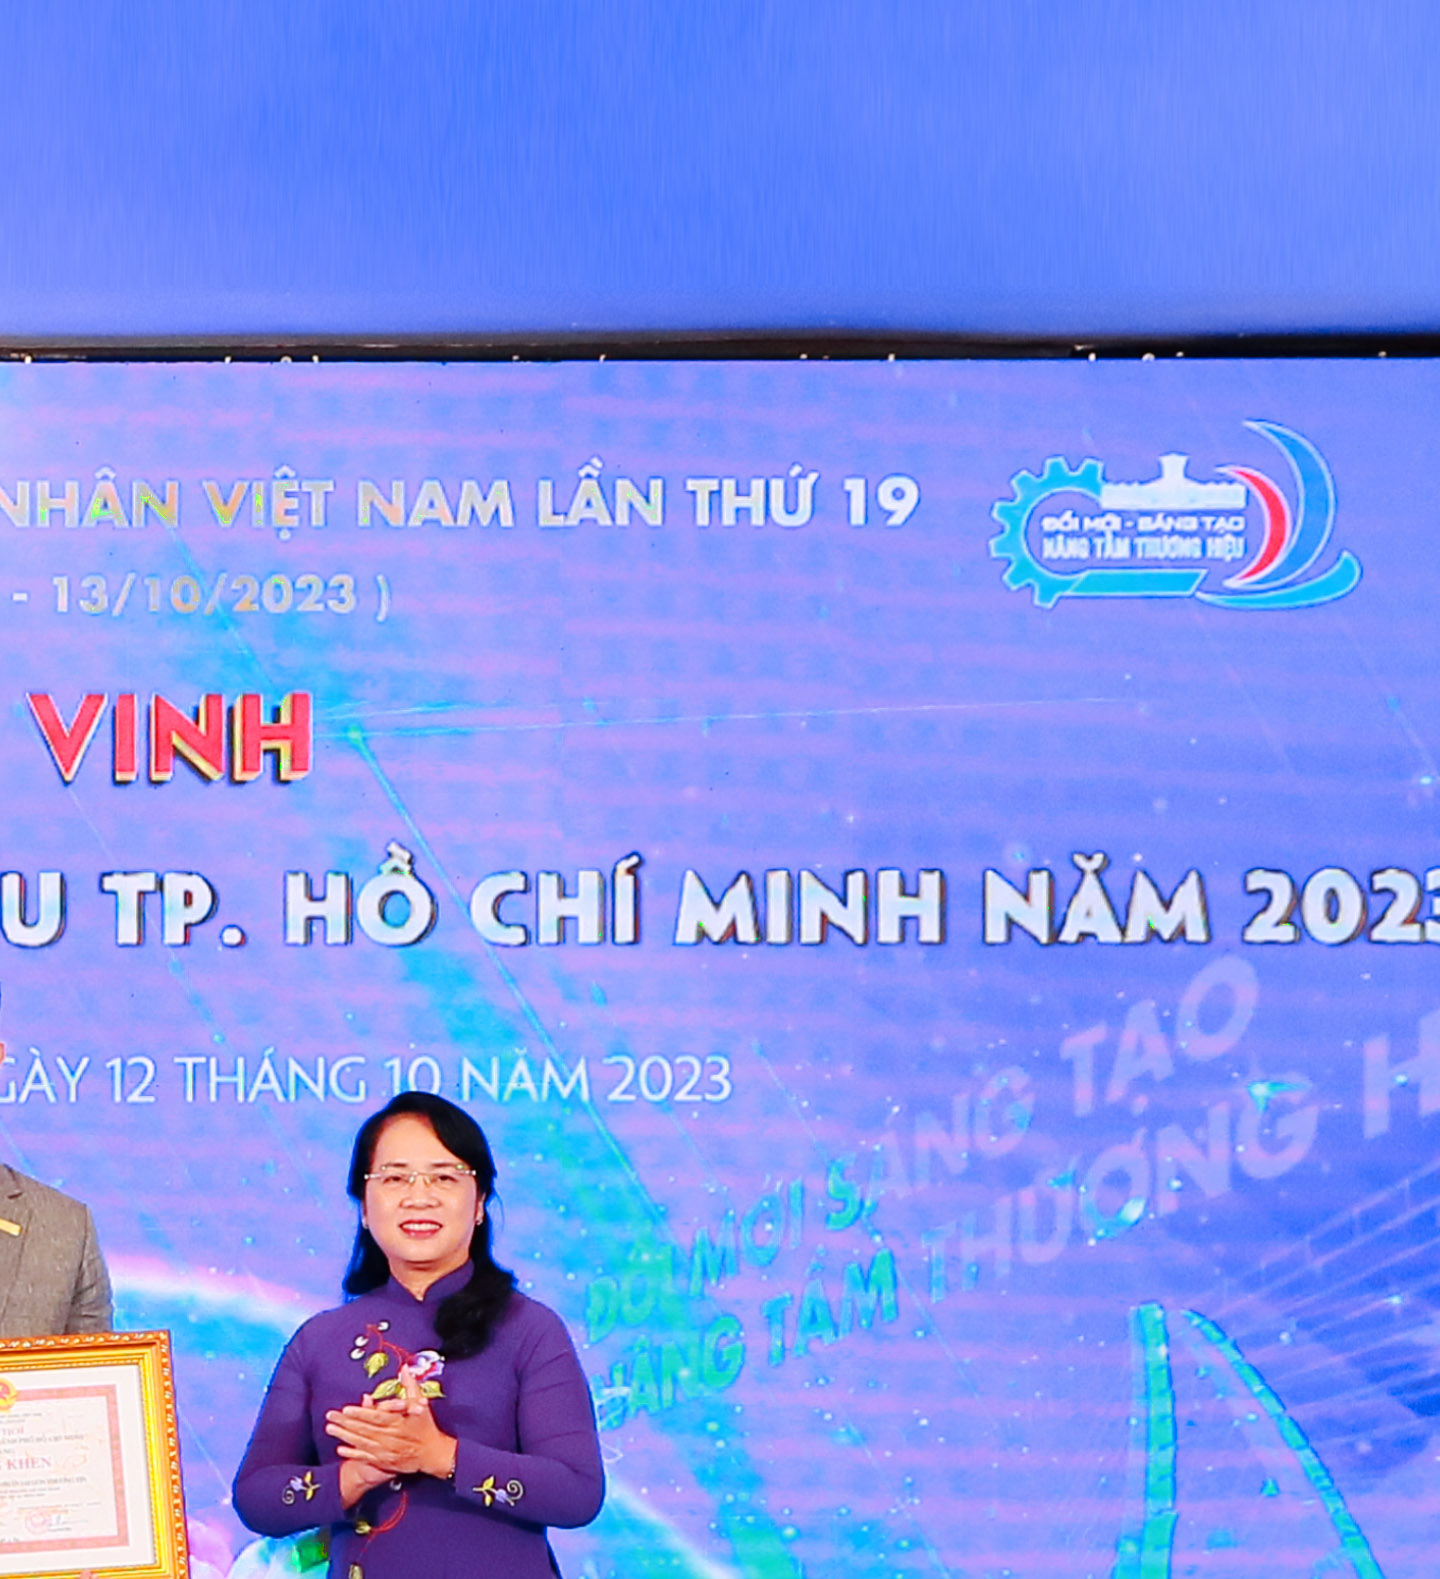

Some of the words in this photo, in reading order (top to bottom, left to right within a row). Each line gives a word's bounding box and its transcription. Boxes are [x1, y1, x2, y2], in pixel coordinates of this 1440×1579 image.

[202, 466, 334, 541] VIỆT
[357, 477, 513, 528] NAM
[537, 457, 668, 528] LẦN
[686, 466, 822, 528] THỨ
[845, 475, 920, 528] 19
[1201, 516, 1245, 534] TẠO
[52, 575, 358, 617] 13/10/2023
[26, 690, 315, 784] VINH
[101, 870, 248, 948] TP.
[286, 841, 436, 948] HỒ
[469, 854, 643, 948] CHÍ
[674, 867, 946, 947] MINH
[983, 851, 1212, 947] NĂM
[1062, 954, 1262, 1122] TẠO
[107, 1056, 156, 1104] 12
[173, 1046, 367, 1103] THÁNG
[384, 1055, 442, 1099] 10
[460, 1047, 590, 1103] NĂM
[607, 1055, 734, 1103] 2023
[7, 1455, 52, 1471] KHEN
